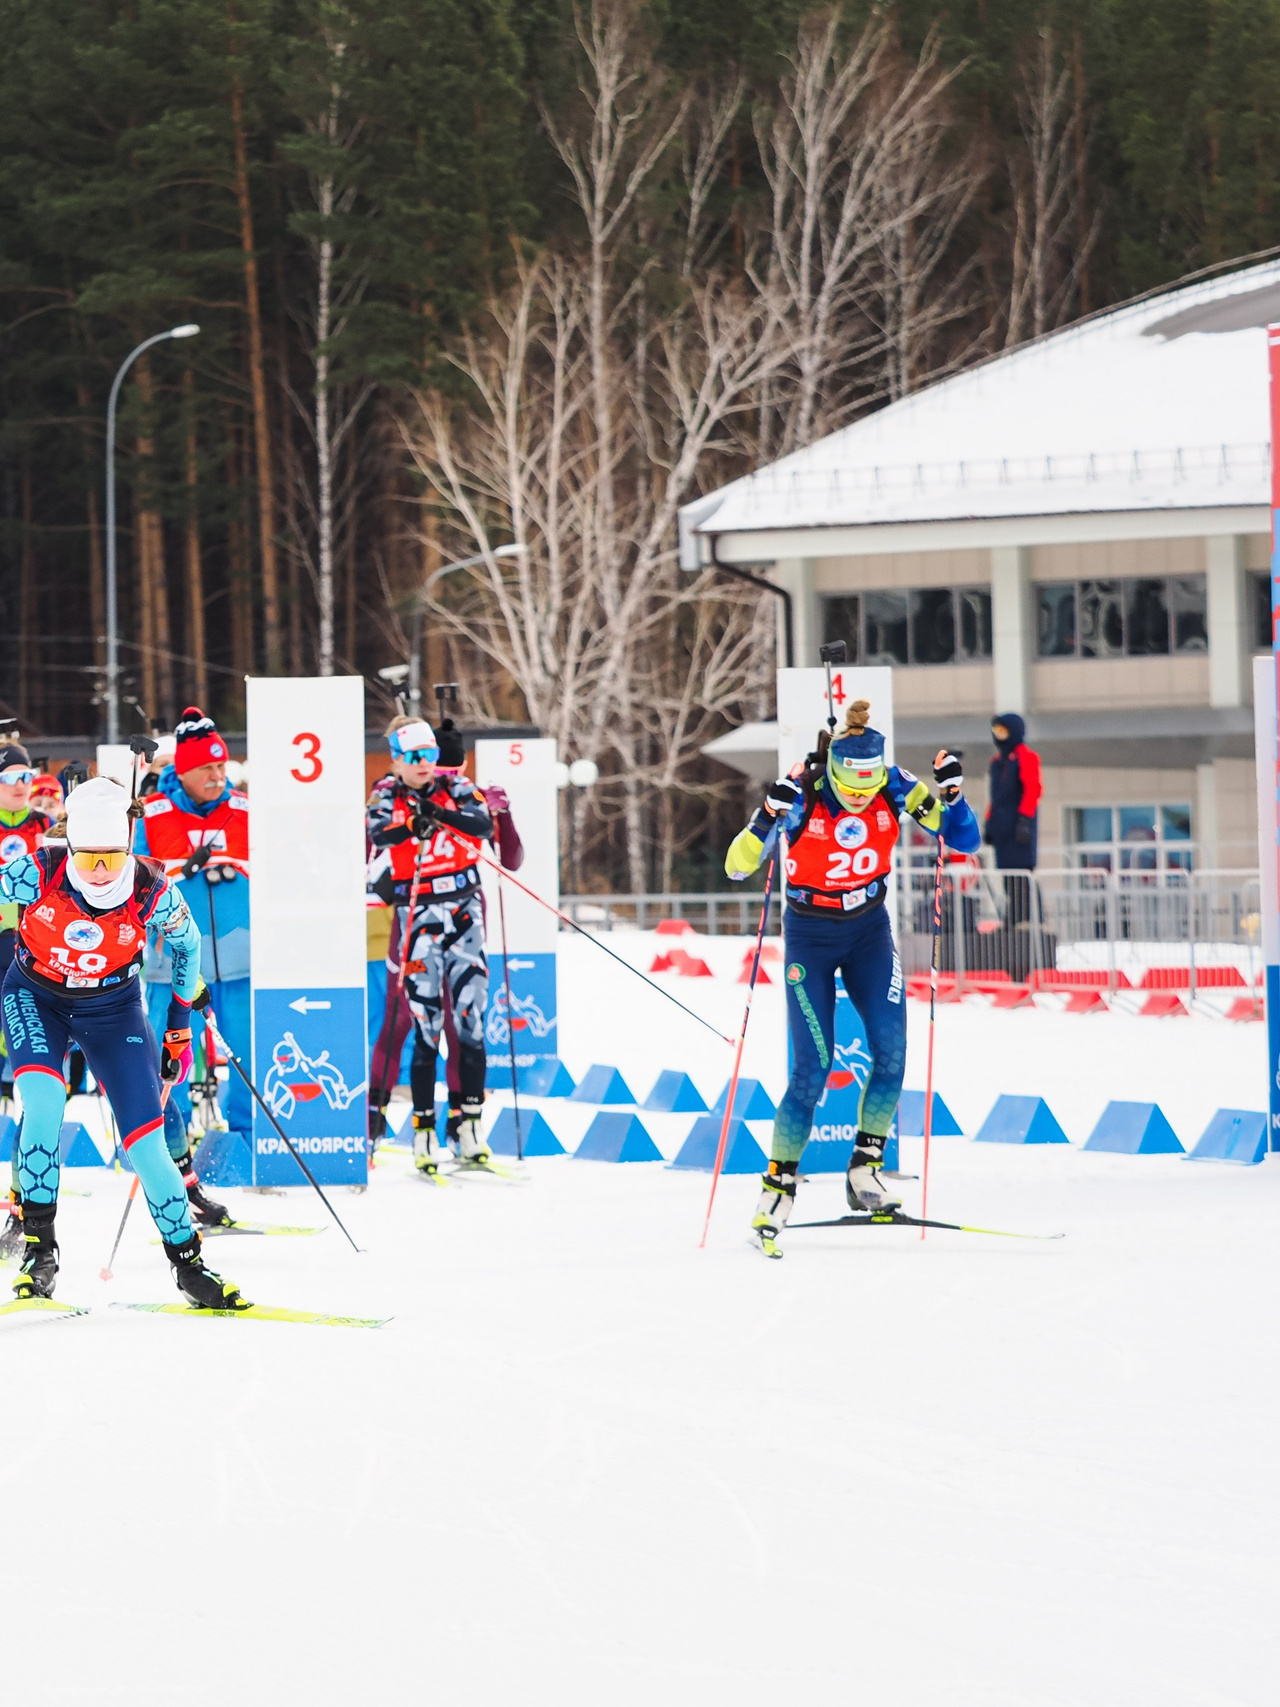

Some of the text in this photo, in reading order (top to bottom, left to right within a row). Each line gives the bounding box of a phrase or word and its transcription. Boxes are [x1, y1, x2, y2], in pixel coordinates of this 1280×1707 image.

[290, 732, 323, 783] 3
[509, 743, 524, 765] 5
[825, 847, 878, 880] 20
[3, 993, 28, 1050] ОБЛАСТЬ
[18, 987, 49, 1054] ЮМЕНСКАЯ
[810, 1123, 897, 1142] АСНОК
[866, 1137, 882, 1146] 170
[257, 1136, 366, 1155] КРАСНОЯРСК
[178, 1248, 195, 1260] 168
